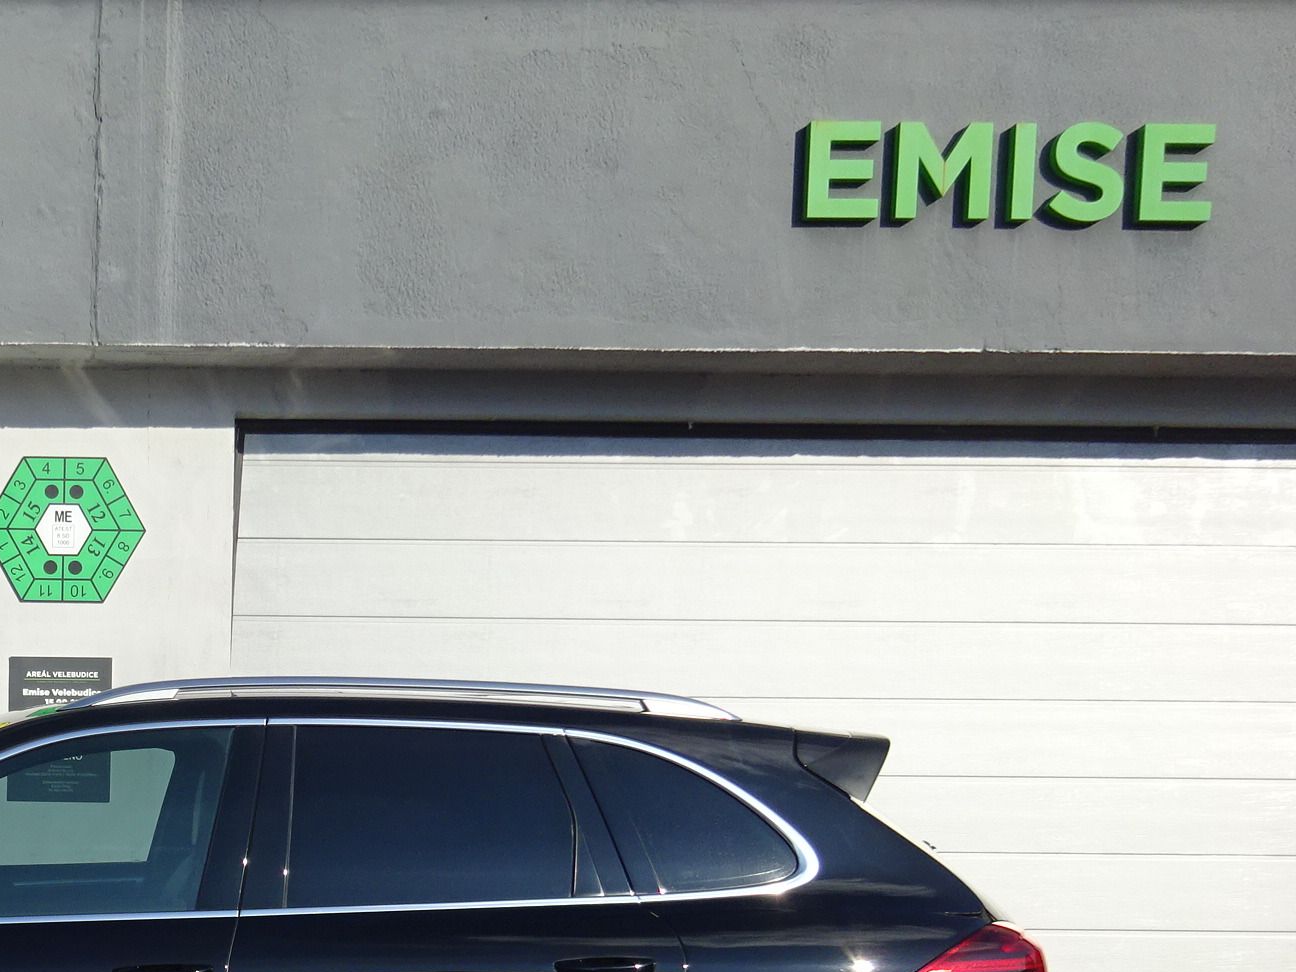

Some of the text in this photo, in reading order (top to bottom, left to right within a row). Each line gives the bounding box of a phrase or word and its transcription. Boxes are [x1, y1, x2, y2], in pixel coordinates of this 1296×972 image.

[800, 120, 1217, 224] EMISE
[42, 462, 50, 475] 4
[76, 462, 85, 475] 5
[13, 479, 26, 491] 3
[22, 500, 41, 522] 15
[54, 510, 73, 523] ME
[87, 502, 106, 523] 12
[119, 509, 132, 519] 7
[20, 533, 41, 555] 14
[87, 537, 106, 557] 13
[117, 541, 130, 553] 8
[10, 563, 26, 582] 12
[39, 584, 53, 597] 11
[70, 584, 87, 597] 10
[26, 670, 51, 678] AREÁL
[22, 688, 50, 696] Emise
